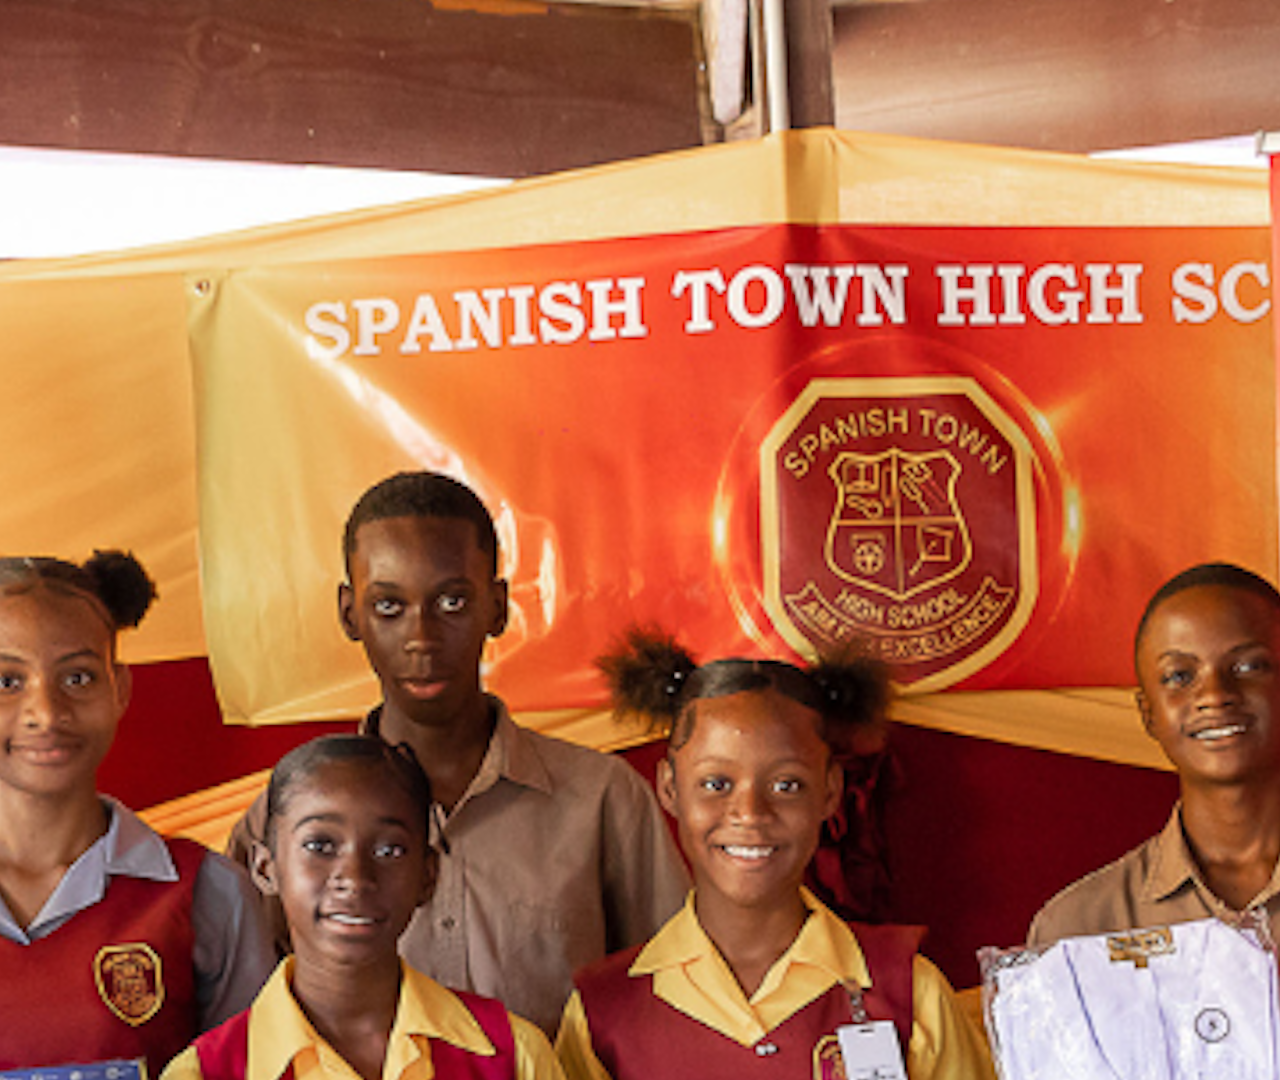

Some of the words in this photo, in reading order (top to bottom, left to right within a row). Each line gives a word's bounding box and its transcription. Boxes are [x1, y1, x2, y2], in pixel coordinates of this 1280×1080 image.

[305, 278, 647, 360] SPANISH
[671, 261, 909, 333] TOWN
[936, 264, 1144, 325] HIGH
[783, 408, 909, 480] SPANISH
[919, 408, 1008, 475] TOWN
